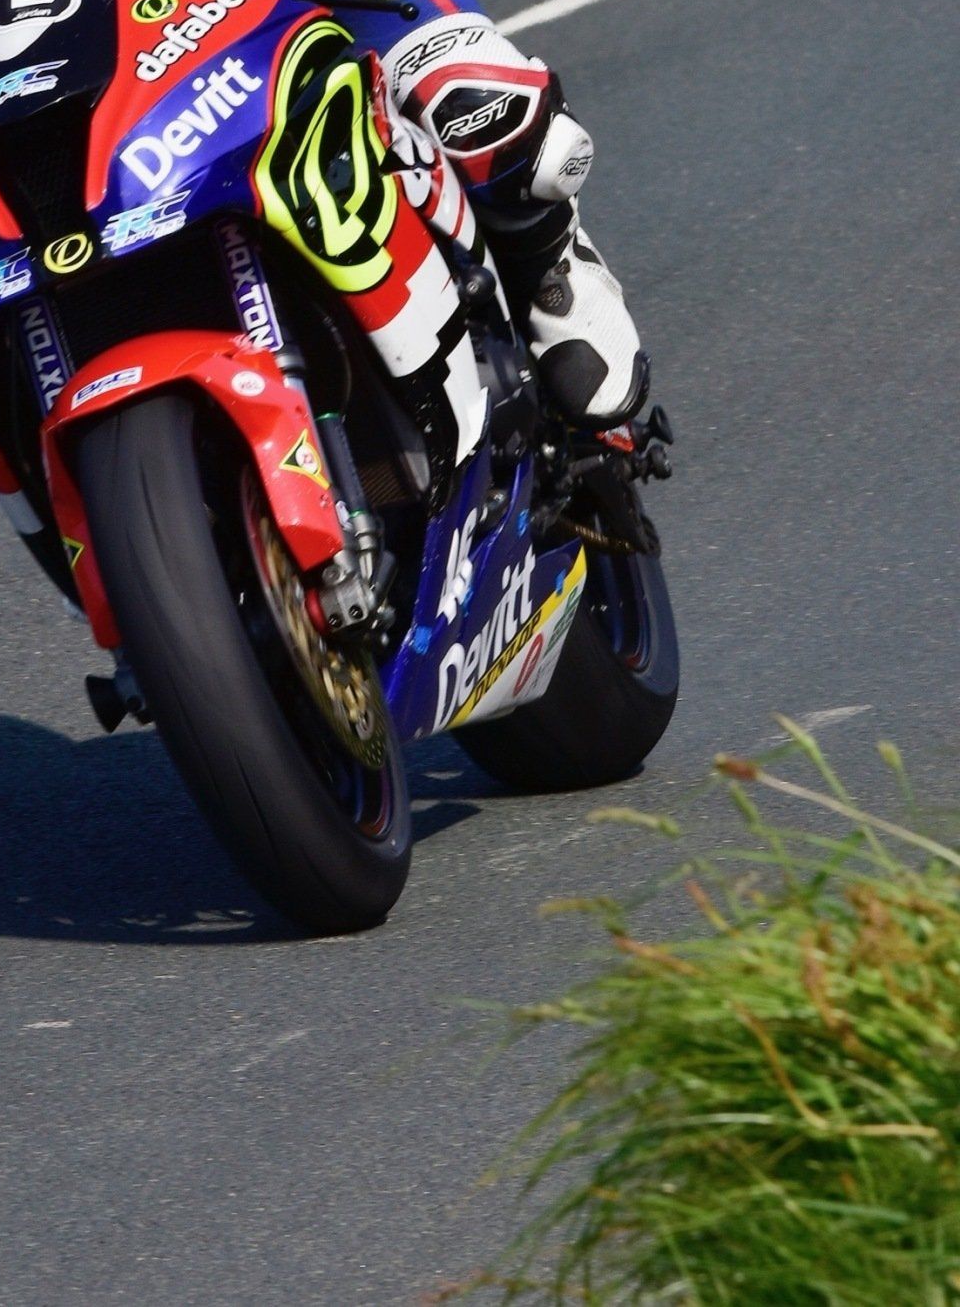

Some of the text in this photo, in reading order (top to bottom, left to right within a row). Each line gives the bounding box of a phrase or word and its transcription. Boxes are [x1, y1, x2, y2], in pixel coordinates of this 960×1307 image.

[394, 26, 486, 82] RST
[119, 56, 264, 192] Devitt
[440, 92, 518, 143] RST
[21, 305, 66, 412] XTON
[431, 542, 536, 735] Devitt
